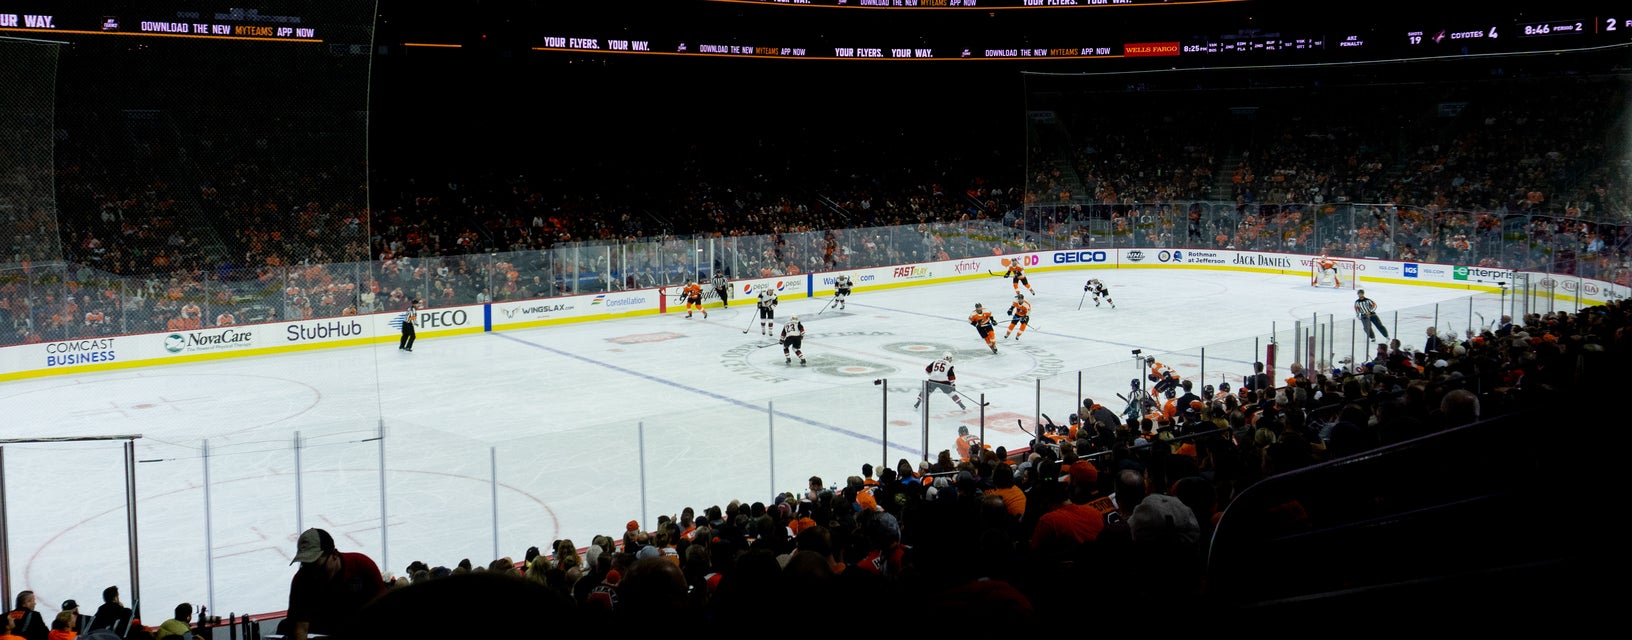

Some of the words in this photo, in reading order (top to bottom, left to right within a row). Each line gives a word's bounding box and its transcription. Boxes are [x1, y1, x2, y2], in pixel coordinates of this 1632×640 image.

[24, 14, 55, 28] WAY.
[1606, 18, 1616, 31] 2
[141, 21, 188, 33] DOWNLOAD
[192, 23, 208, 34] THE
[212, 24, 230, 34] NEW
[235, 25, 273, 36] MYTEAMS
[277, 27, 292, 37] APP
[296, 28, 314, 38] NOW
[1451, 31, 1483, 39] COYOTES
[1488, 27, 1498, 38] 4
[1525, 24, 1550, 35] 8:46
[1575, 23, 1582, 31] 2
[544, 37, 565, 47] YOUR
[570, 38, 600, 49] FLYERS.
[608, 40, 628, 50] YOUR
[632, 41, 650, 51] WAY.
[700, 44, 728, 53] DOWNLOAD
[835, 48, 854, 57] YOUR
[857, 48, 883, 57] FLYERS.
[892, 48, 911, 57] YOUR
[915, 49, 933, 57] WAY.
[1053, 251, 1106, 264] GEICO
[1233, 253, 1255, 266] JACK
[1258, 255, 1291, 268] DANIEL'S
[954, 261, 980, 274] xfinity
[1341, 262, 1366, 271] ARGO
[752, 282, 769, 291] pepsi
[785, 279, 801, 288] pepsi
[606, 296, 646, 307] Constellation
[420, 309, 467, 328] PECO
[287, 320, 361, 341] StubHub
[786, 324, 795, 332] 23
[187, 330, 252, 346] NovaCare
[46, 339, 114, 354] COMCAST
[47, 351, 115, 366] BUSINESS
